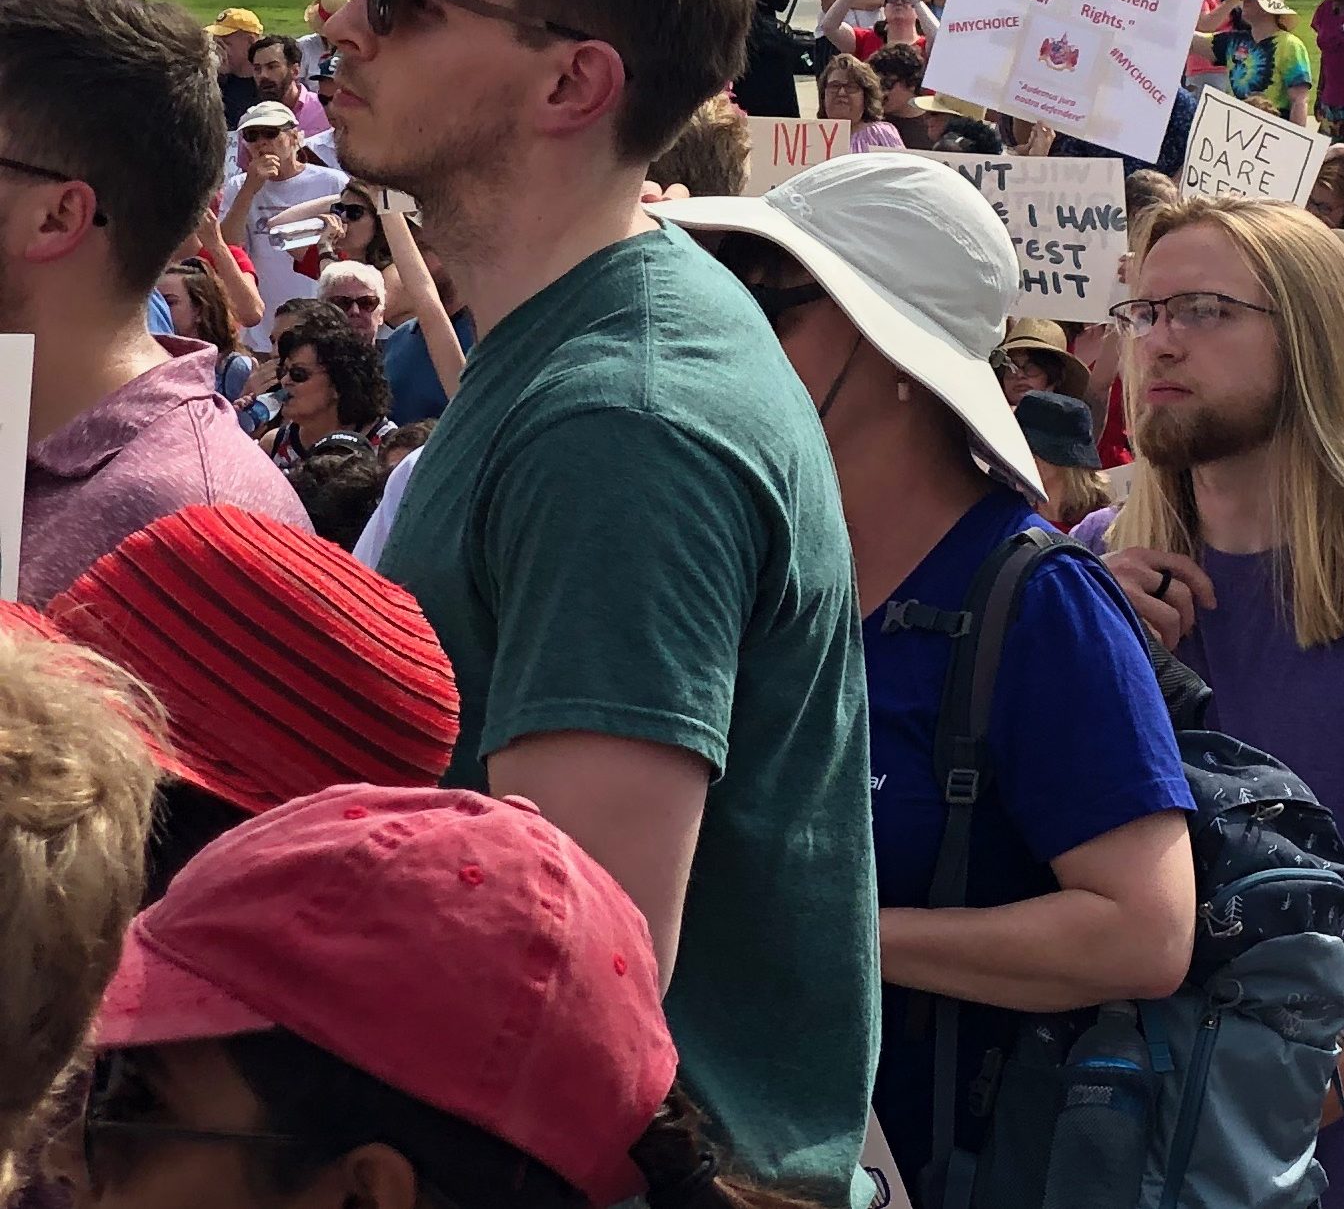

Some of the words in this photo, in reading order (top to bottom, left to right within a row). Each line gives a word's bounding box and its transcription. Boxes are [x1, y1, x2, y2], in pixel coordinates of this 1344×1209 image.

[948, 16, 1020, 33] #MYCHOICE
[1109, 47, 1167, 106] #MYCHOICE
[1225, 109, 1280, 165] WE
[943, 160, 1013, 192] N'T
[1199, 137, 1275, 195] DARE
[1028, 203, 1037, 228] I
[1056, 204, 1128, 233] HAVE
[1018, 269, 1090, 298] HIT
